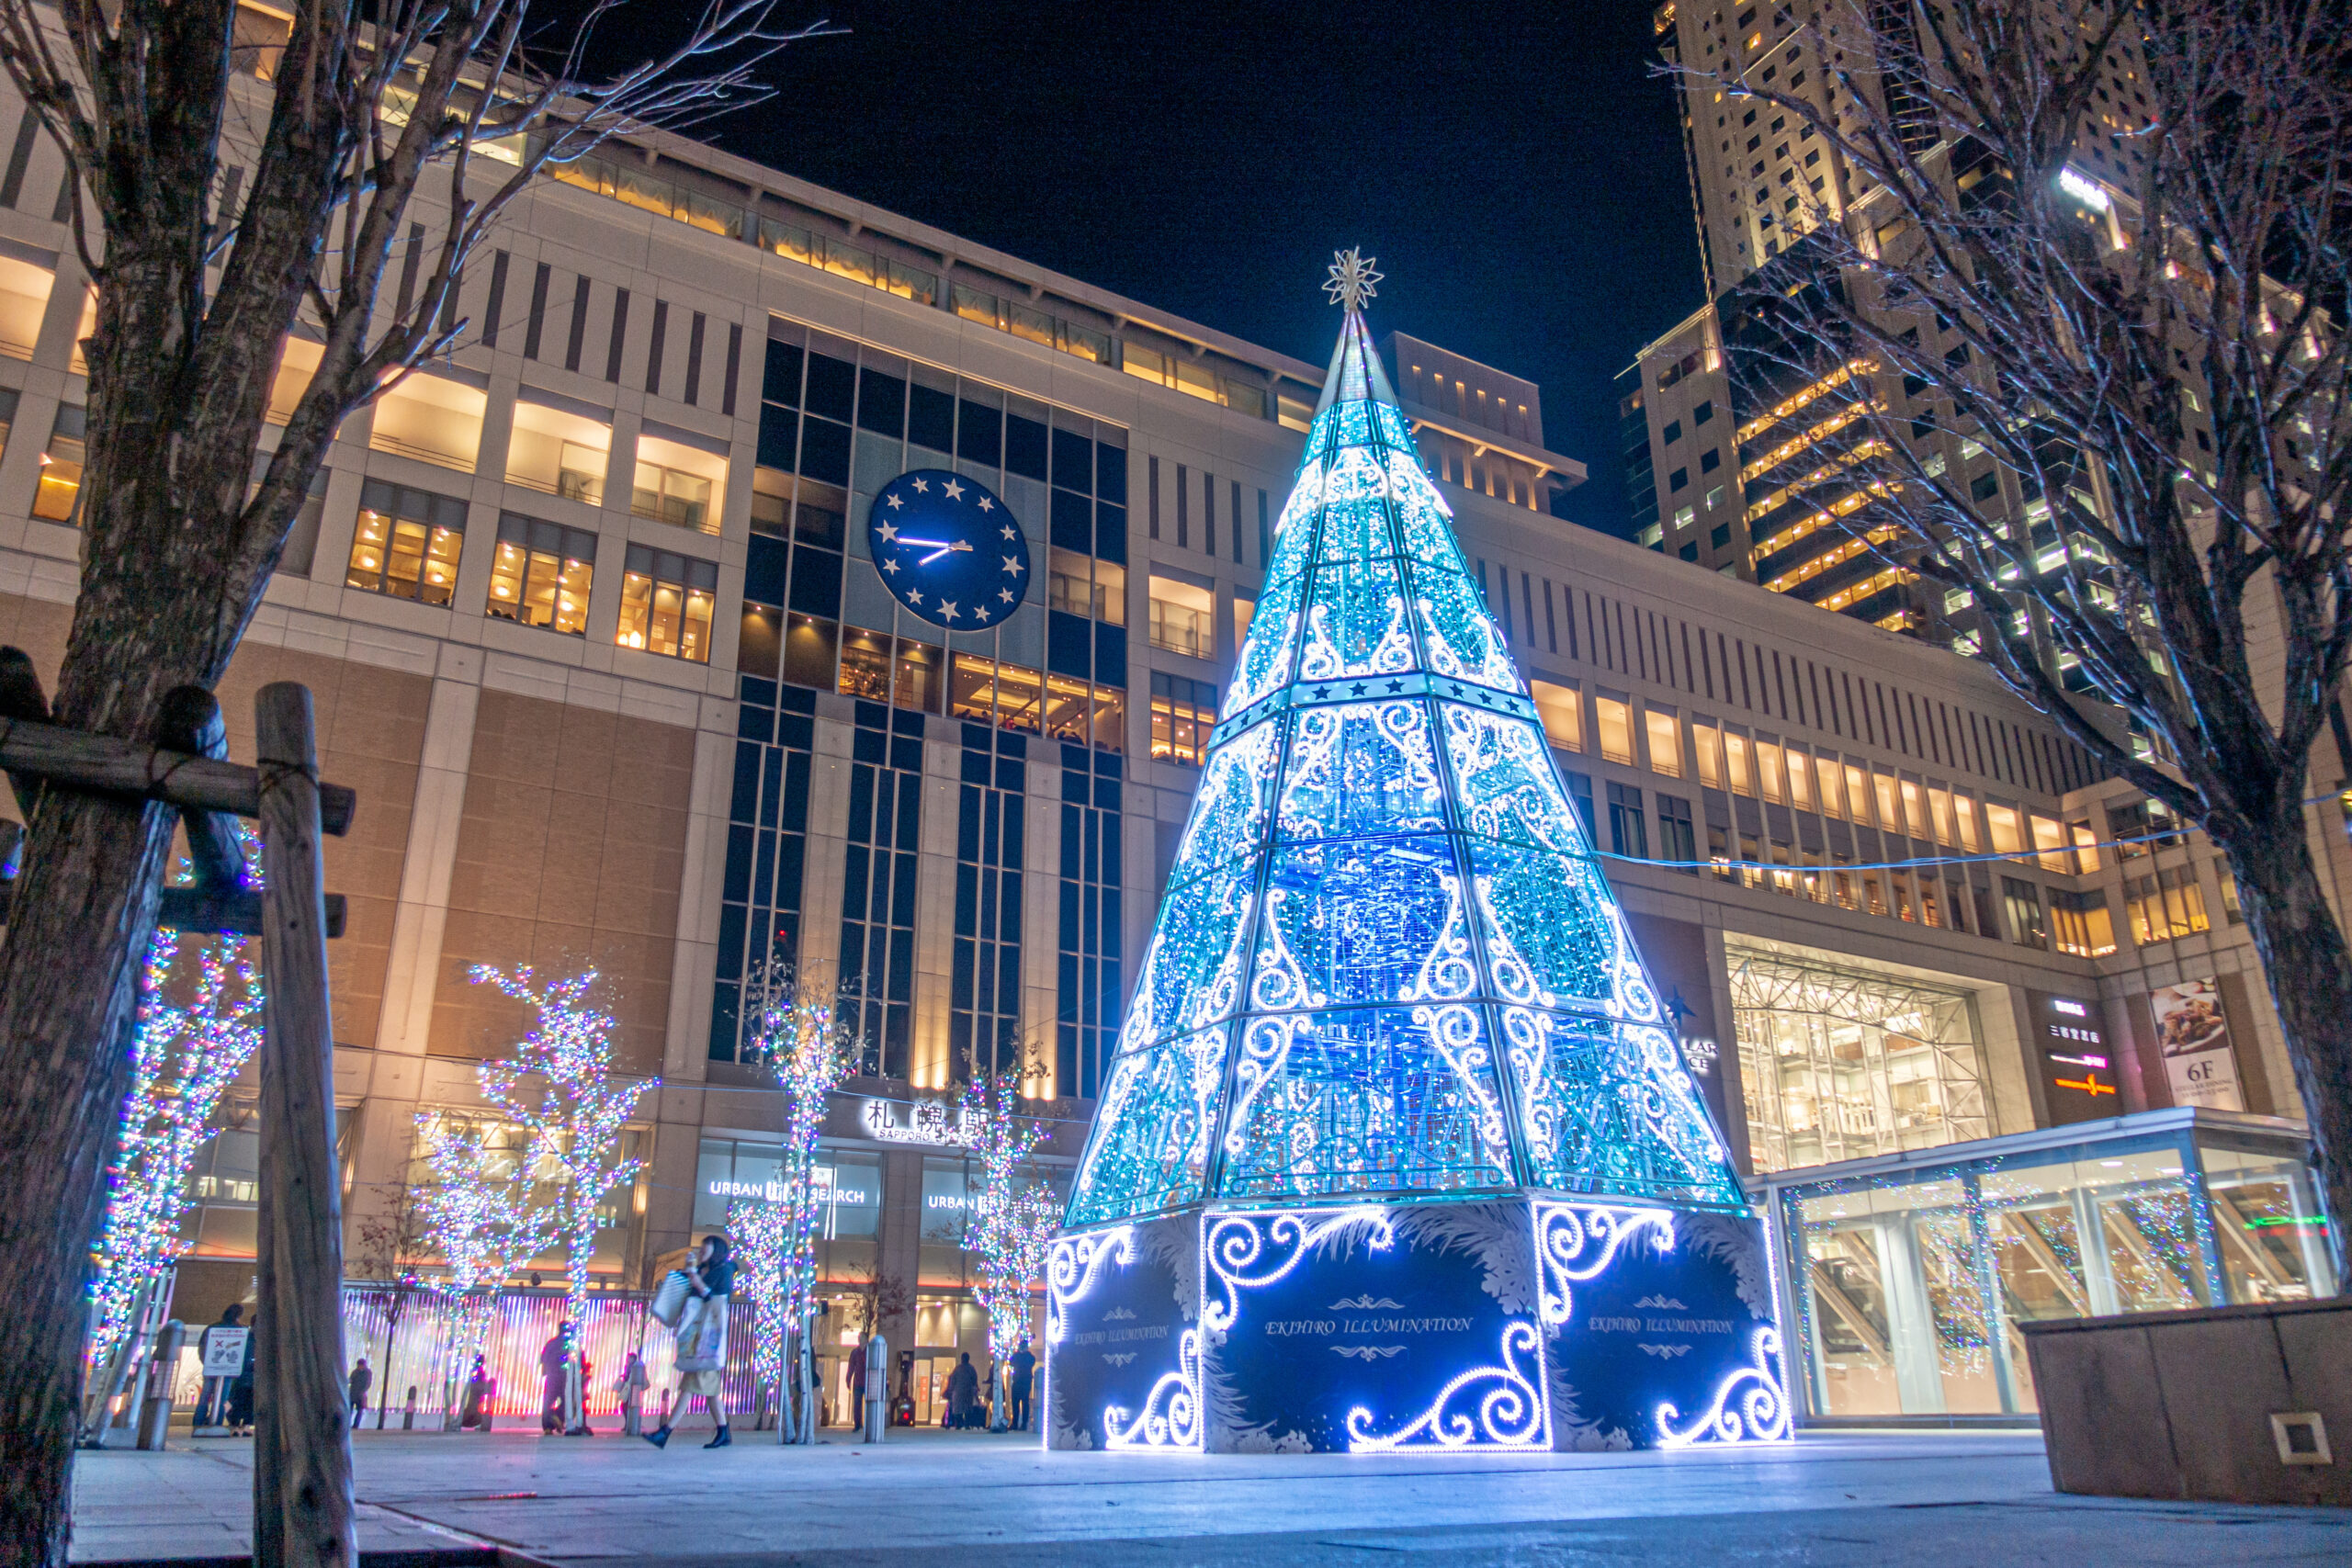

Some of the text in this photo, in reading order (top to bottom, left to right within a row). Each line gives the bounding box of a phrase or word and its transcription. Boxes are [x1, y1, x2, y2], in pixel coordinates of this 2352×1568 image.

[2188, 1060, 2213, 1081] 6F
[879, 1129, 931, 1142] SAPPORO
[709, 1181, 763, 1197] URBAN
[796, 1185, 865, 1204] SEARCH
[928, 1195, 974, 1210] URBAN
[1265, 1317, 1474, 1337] EKIHIRO ILLUMINATION
[1645, 1317, 1734, 1335] ILLUMINATION
